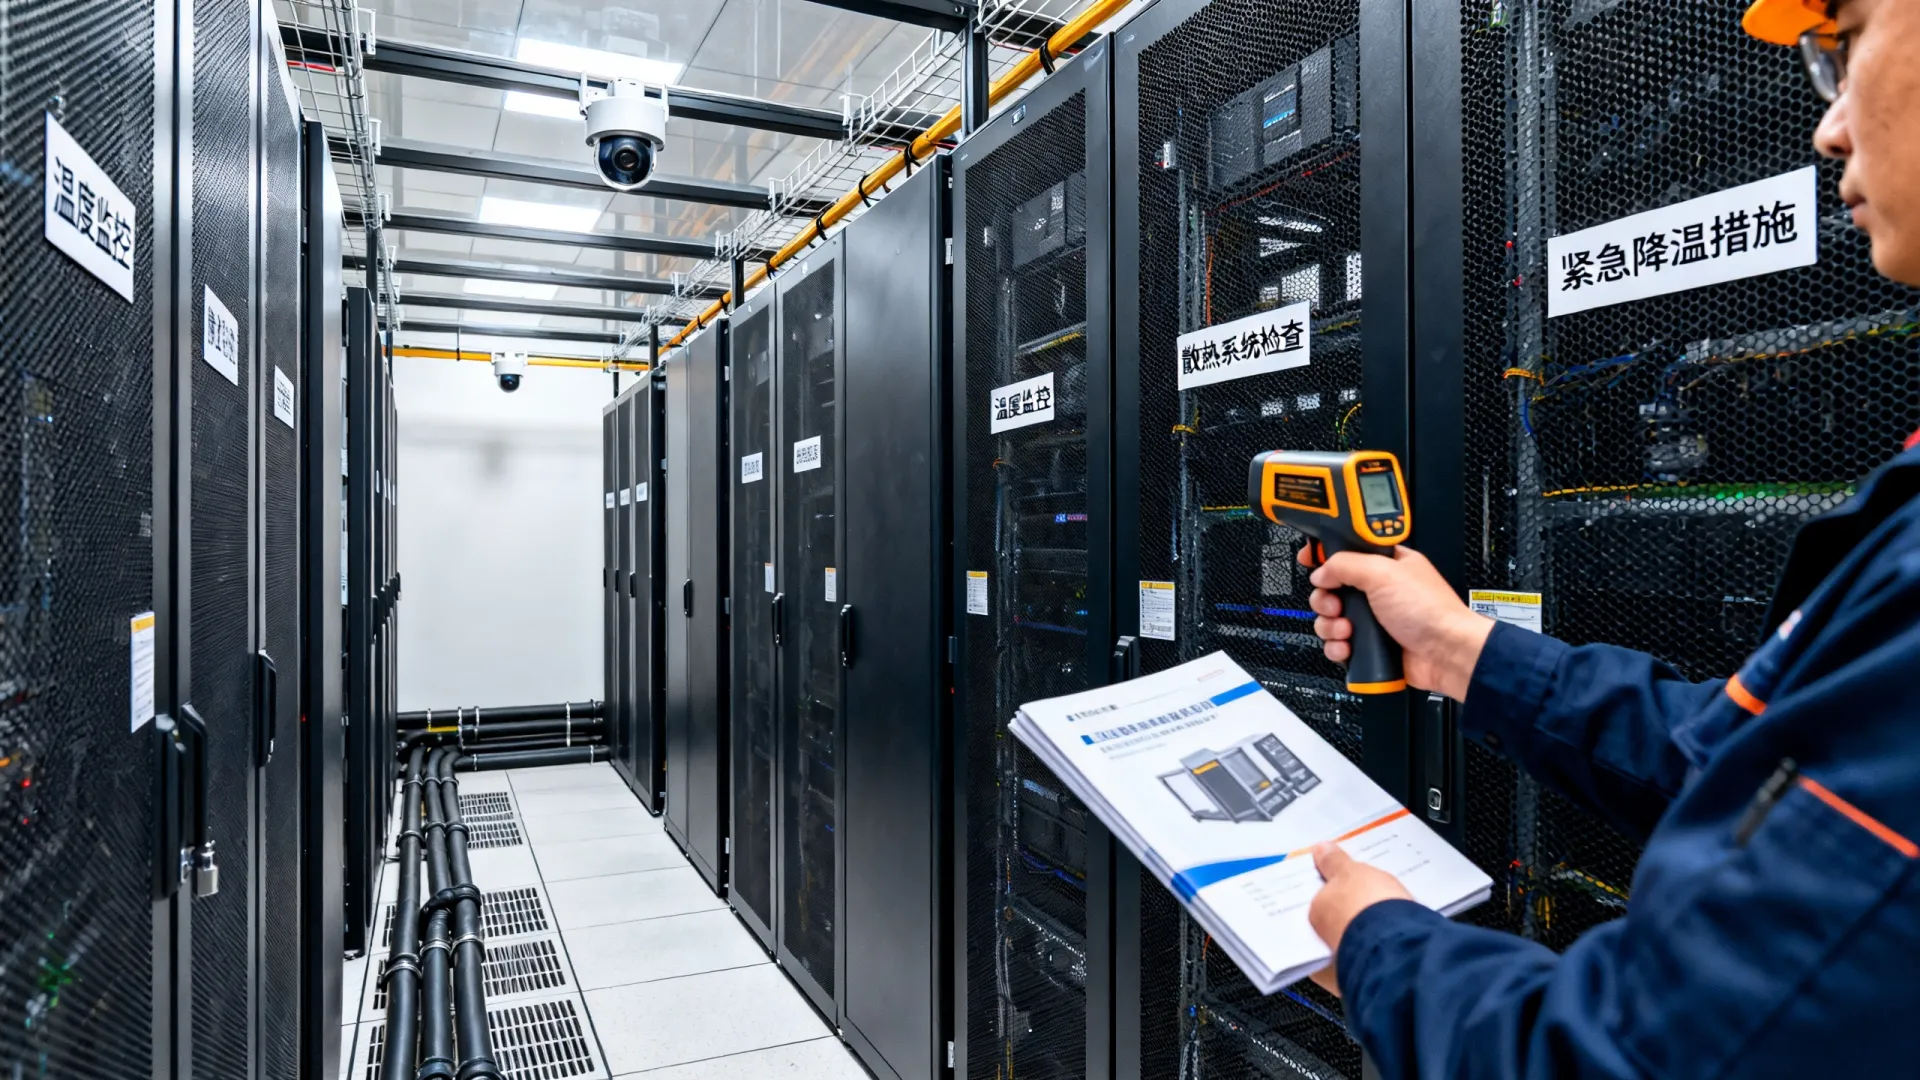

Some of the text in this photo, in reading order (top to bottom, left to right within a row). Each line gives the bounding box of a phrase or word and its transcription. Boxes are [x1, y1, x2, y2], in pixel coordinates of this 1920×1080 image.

[53, 156, 132, 270] 温度监控
[1561, 200, 1798, 292] 紧急降温措施
[1182, 318, 1304, 375] 散热系统检查
